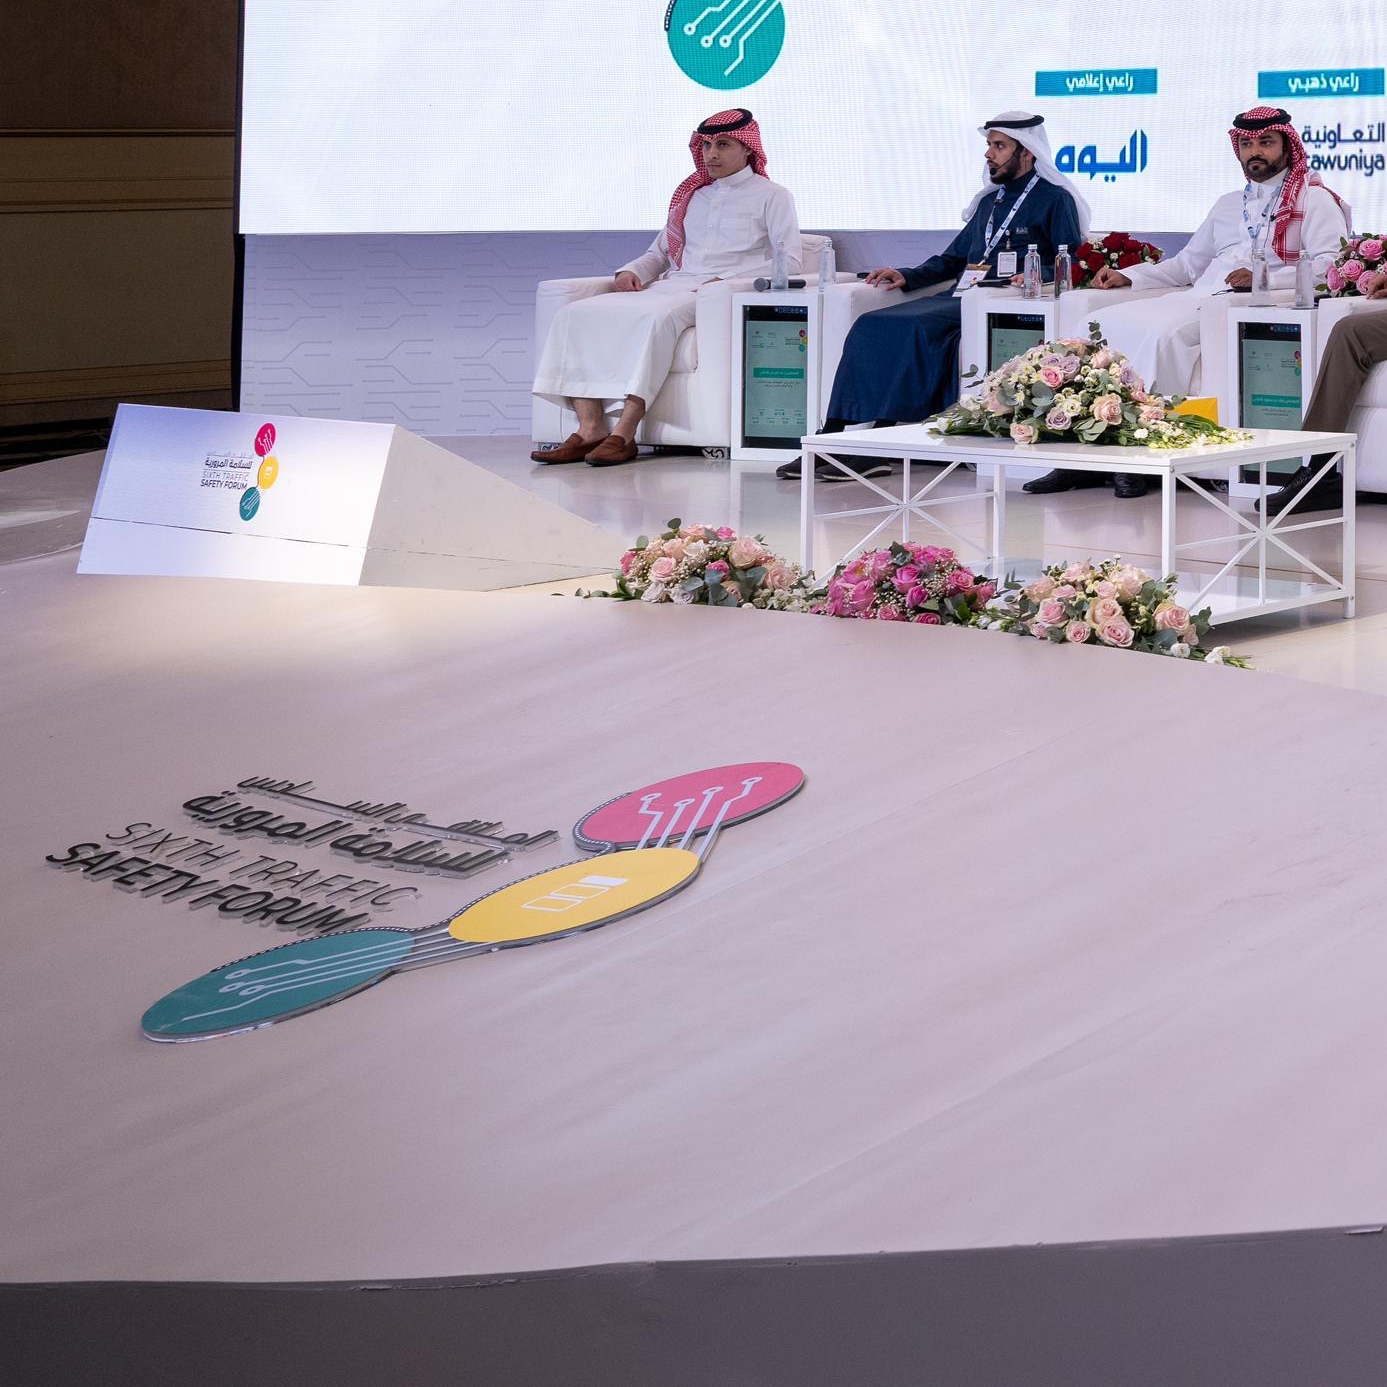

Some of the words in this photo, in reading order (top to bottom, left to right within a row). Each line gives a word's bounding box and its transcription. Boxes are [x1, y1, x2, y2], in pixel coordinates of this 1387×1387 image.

[1106, 72, 1134, 92] راعي
[1329, 71, 1360, 93] راعي
[1302, 123, 1385, 150] التعاونية
[200, 479, 223, 489] SAFETY
[224, 480, 248, 491] FORUM
[106, 821, 241, 869] SIXTH
[229, 854, 420, 910] TRAFFIC
[45, 842, 221, 903] SAFETY
[189, 884, 370, 935] FORUM
